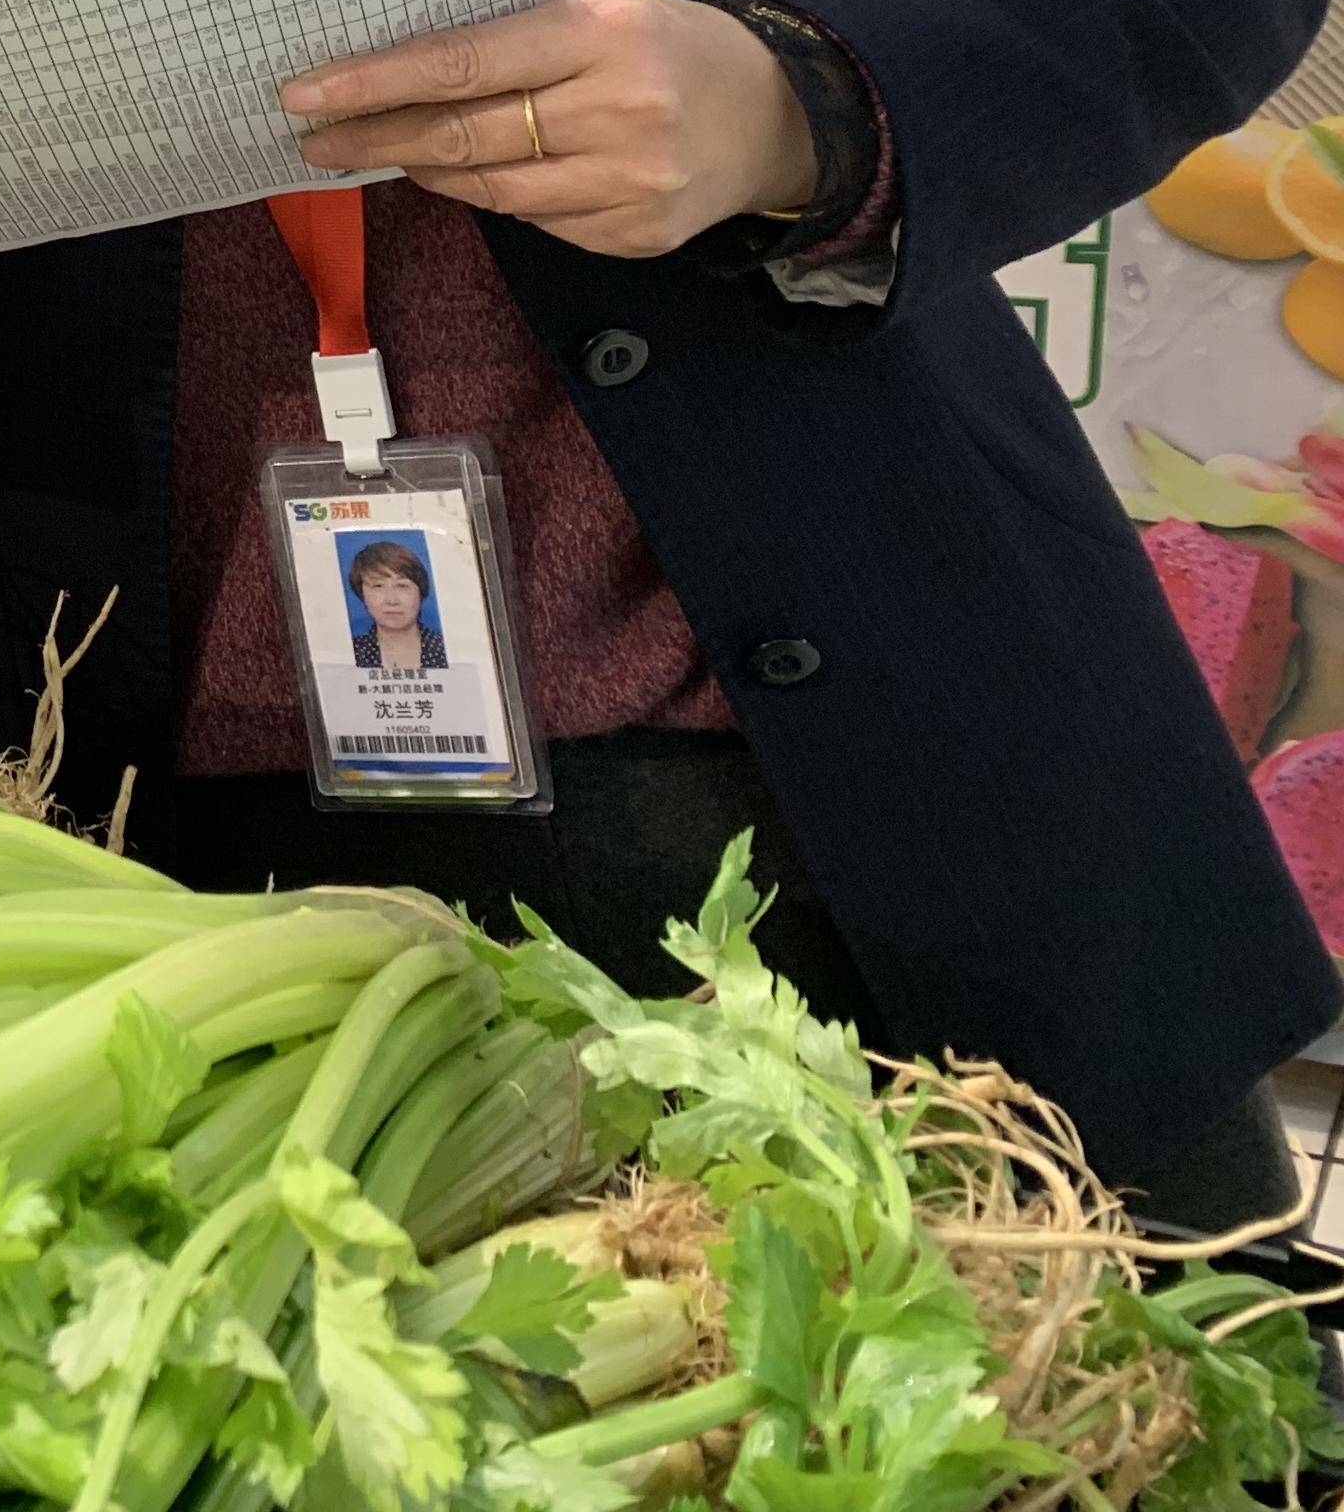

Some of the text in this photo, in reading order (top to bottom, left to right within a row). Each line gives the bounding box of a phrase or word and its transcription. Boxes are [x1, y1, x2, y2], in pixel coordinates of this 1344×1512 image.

[329, 500, 371, 520] 苏果
[374, 700, 434, 719] 沈兰芳
